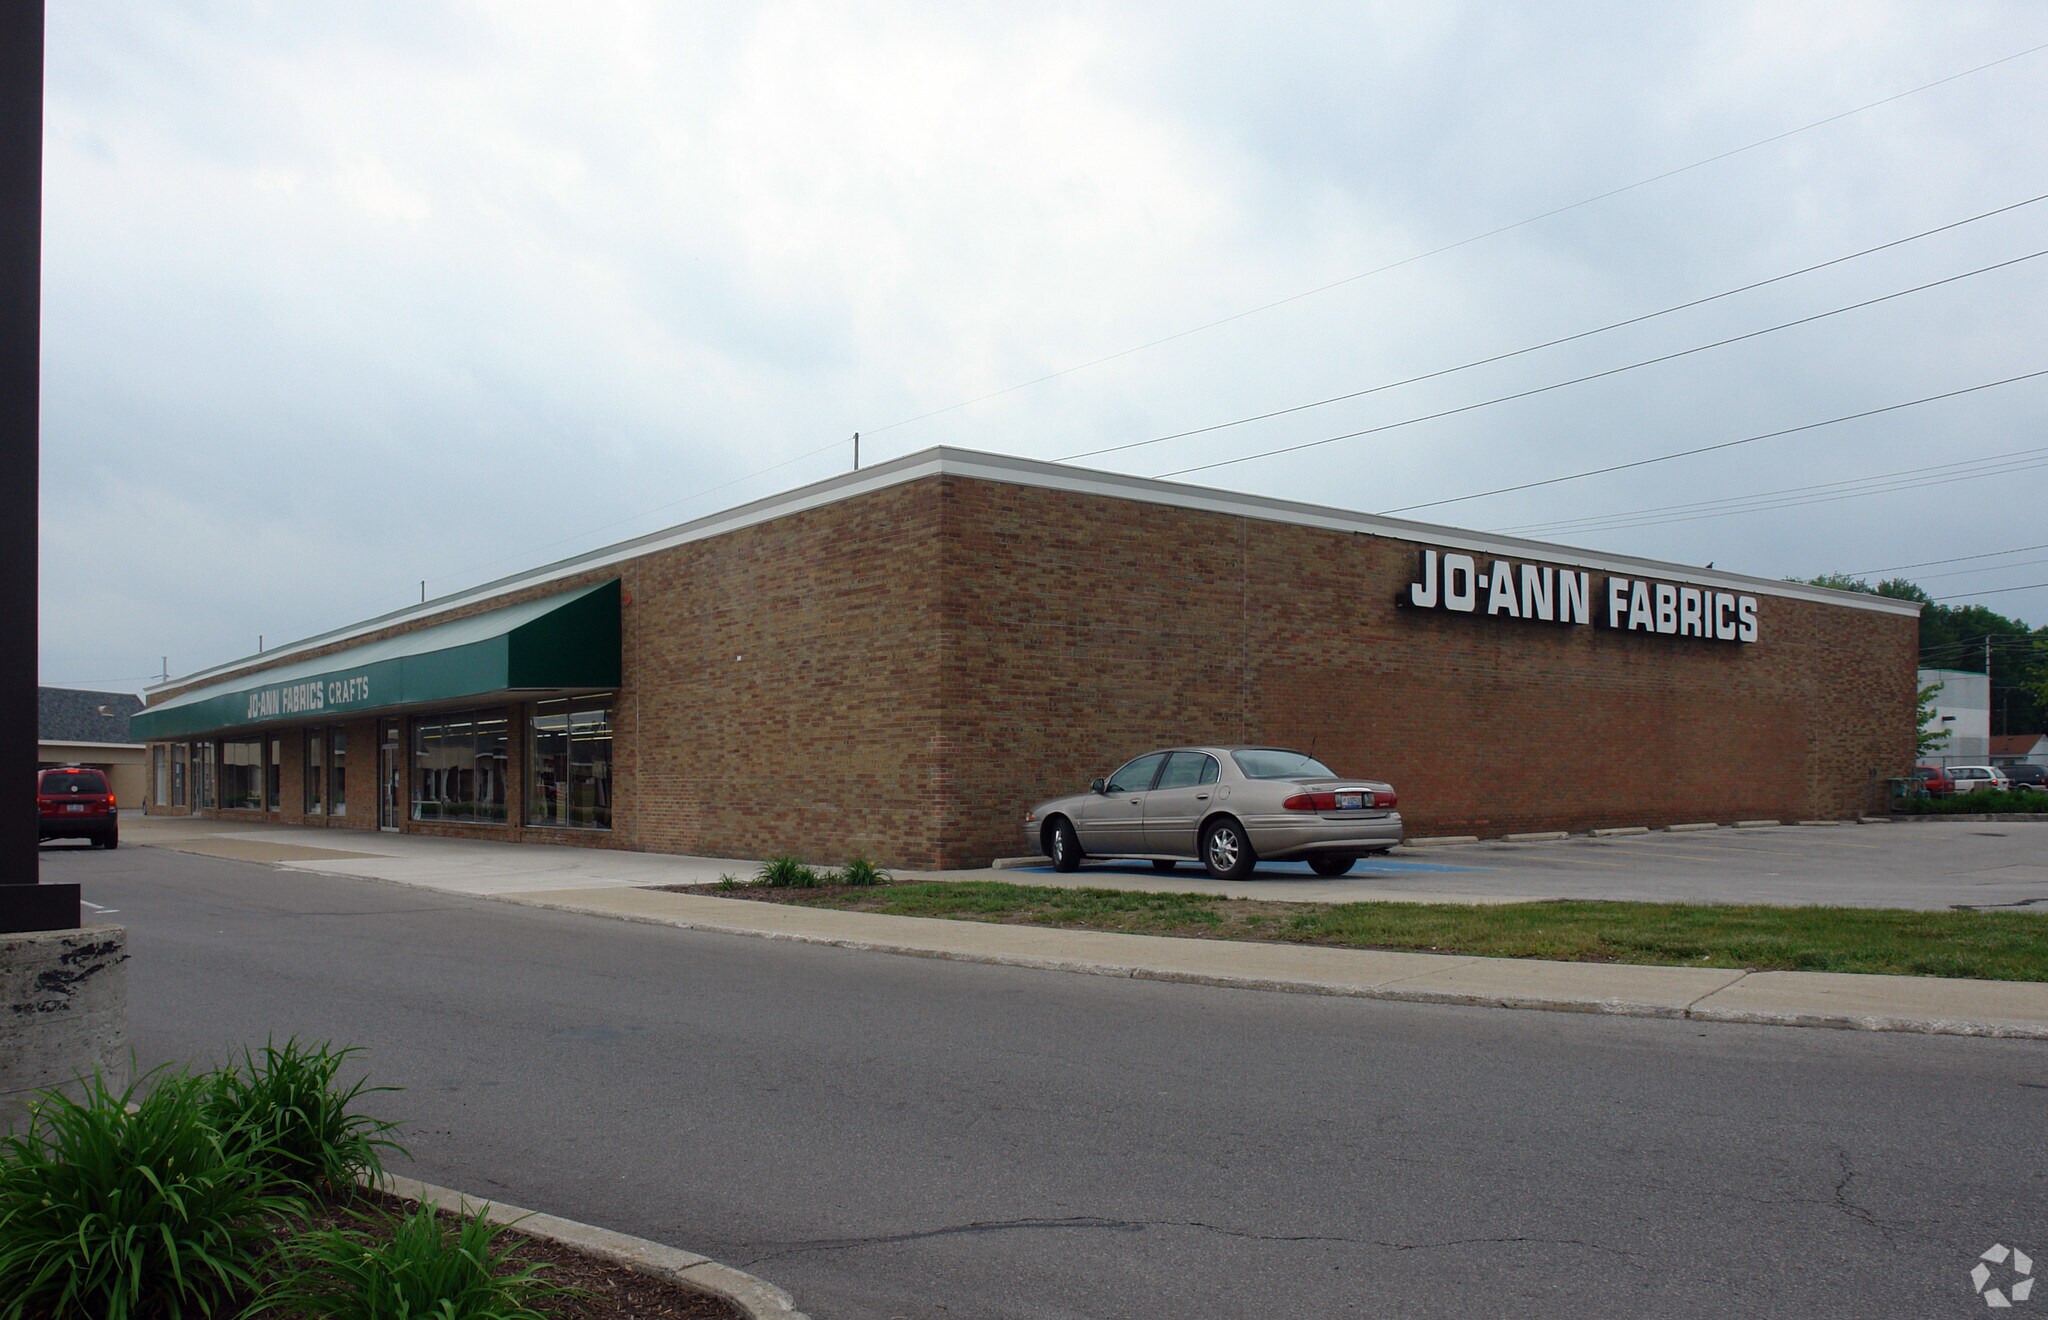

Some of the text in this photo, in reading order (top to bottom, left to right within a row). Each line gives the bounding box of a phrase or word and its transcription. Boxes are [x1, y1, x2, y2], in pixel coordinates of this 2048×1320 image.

[1411, 549, 1758, 643] JO-ANN FABRICS
[282, 681, 324, 713] FABRICS
[328, 675, 369, 704] CRAFTS
